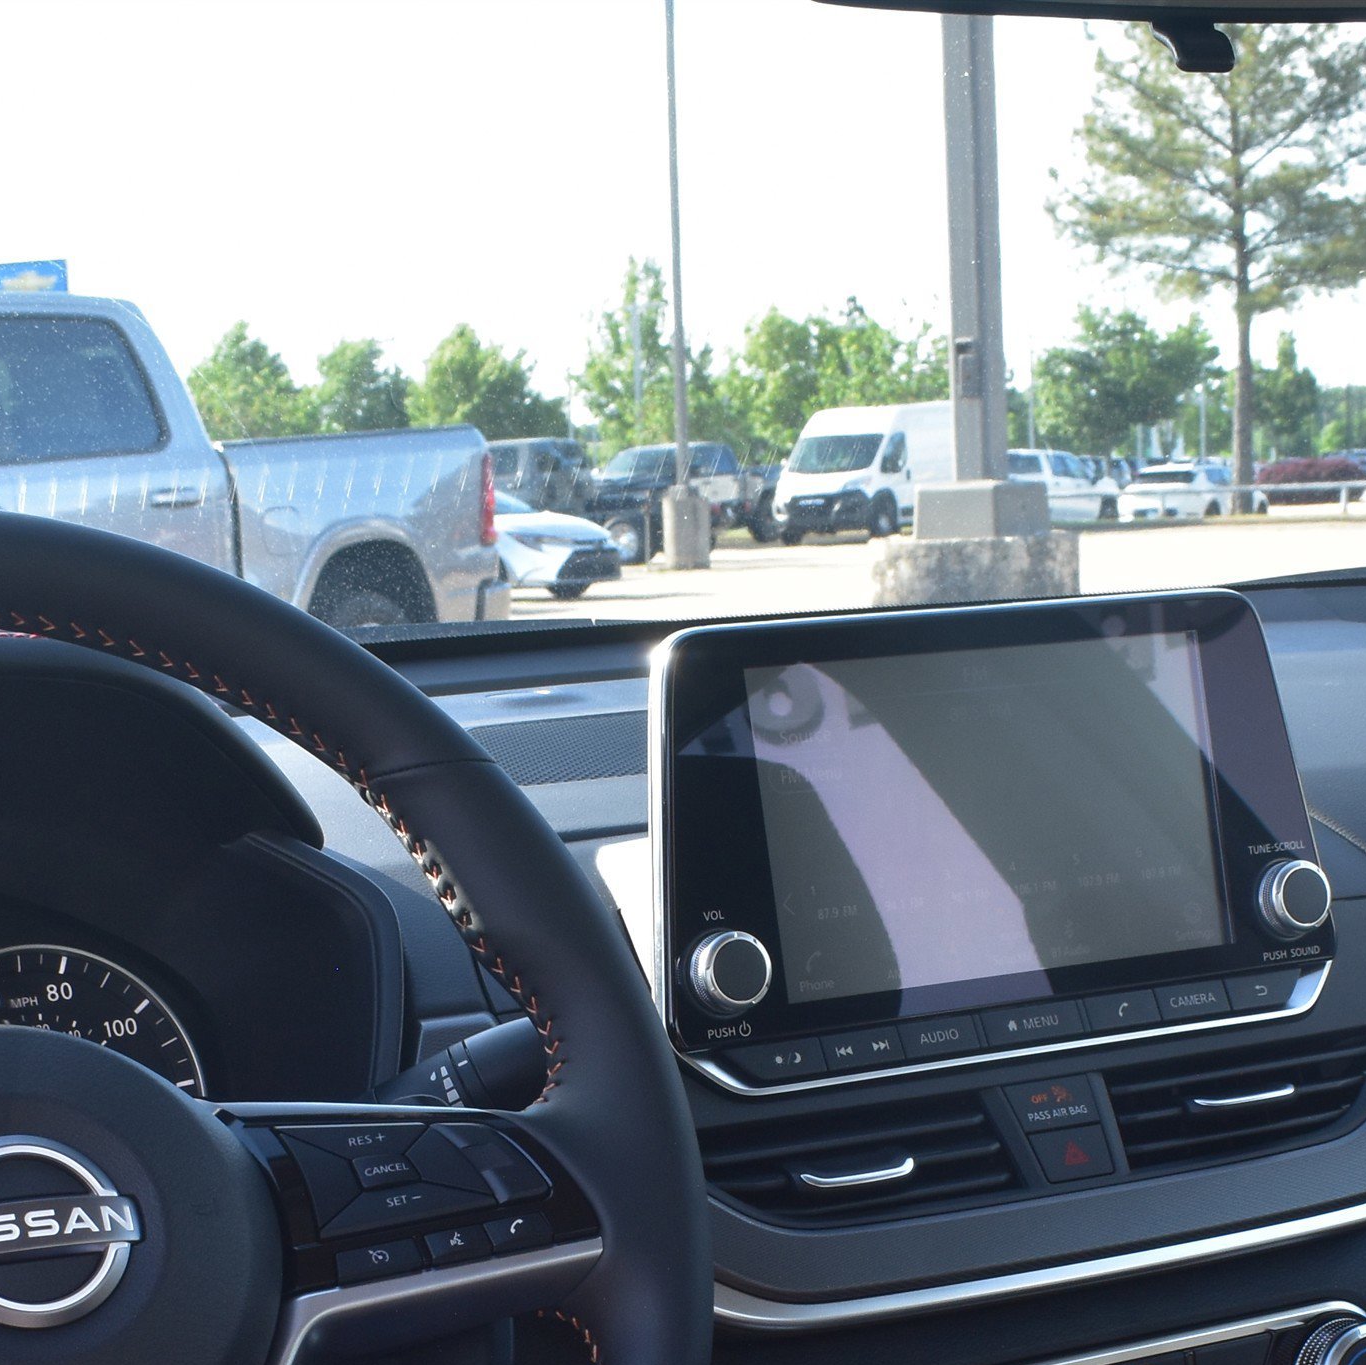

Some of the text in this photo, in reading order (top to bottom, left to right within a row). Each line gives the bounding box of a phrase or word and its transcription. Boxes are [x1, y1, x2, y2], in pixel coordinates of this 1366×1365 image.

[1248, 839, 1306, 855] TUNE-SCROLL
[703, 910, 726, 921] VOL
[1262, 945, 1321, 962] PUSH SOUND
[46, 981, 73, 1002] 80
[9, 996, 39, 1010] MPH
[1169, 992, 1217, 1008] CAMERA
[103, 1016, 138, 1038] 100
[1022, 1014, 1060, 1031] MENU
[707, 1026, 736, 1039] PUSH
[920, 1028, 960, 1045] AUDIO
[1031, 1093, 1048, 1105] OFF
[1028, 1104, 1088, 1122] PASS AIR BAG
[348, 1134, 373, 1147] RES
[364, 1162, 410, 1178] CANCEL
[386, 1194, 408, 1207] SET
